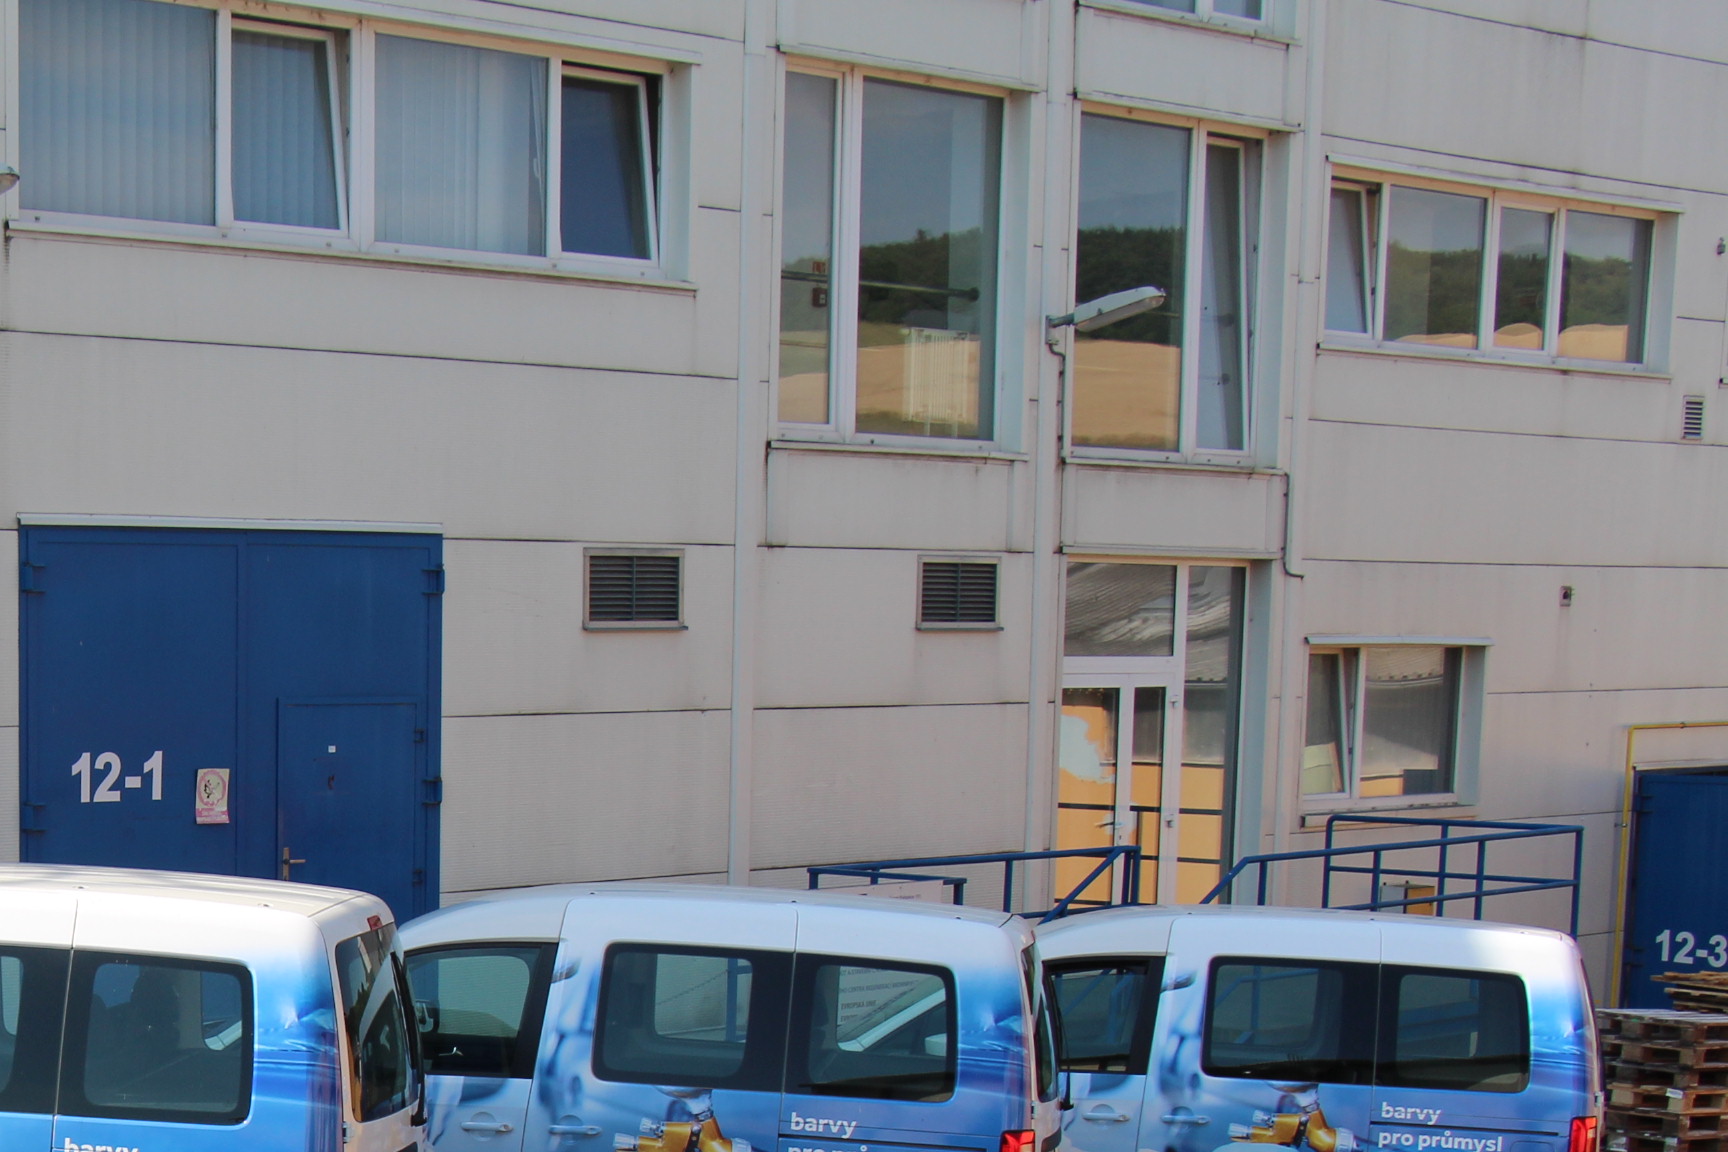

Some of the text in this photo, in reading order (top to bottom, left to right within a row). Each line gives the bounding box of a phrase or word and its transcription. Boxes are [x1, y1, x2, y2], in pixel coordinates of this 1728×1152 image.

[71, 750, 163, 804] 12-1
[1655, 929, 1728, 968] 12-3
[790, 1111, 857, 1139] barvy
[1381, 1101, 1441, 1126] barvy
[1378, 1131, 1414, 1148] pro
